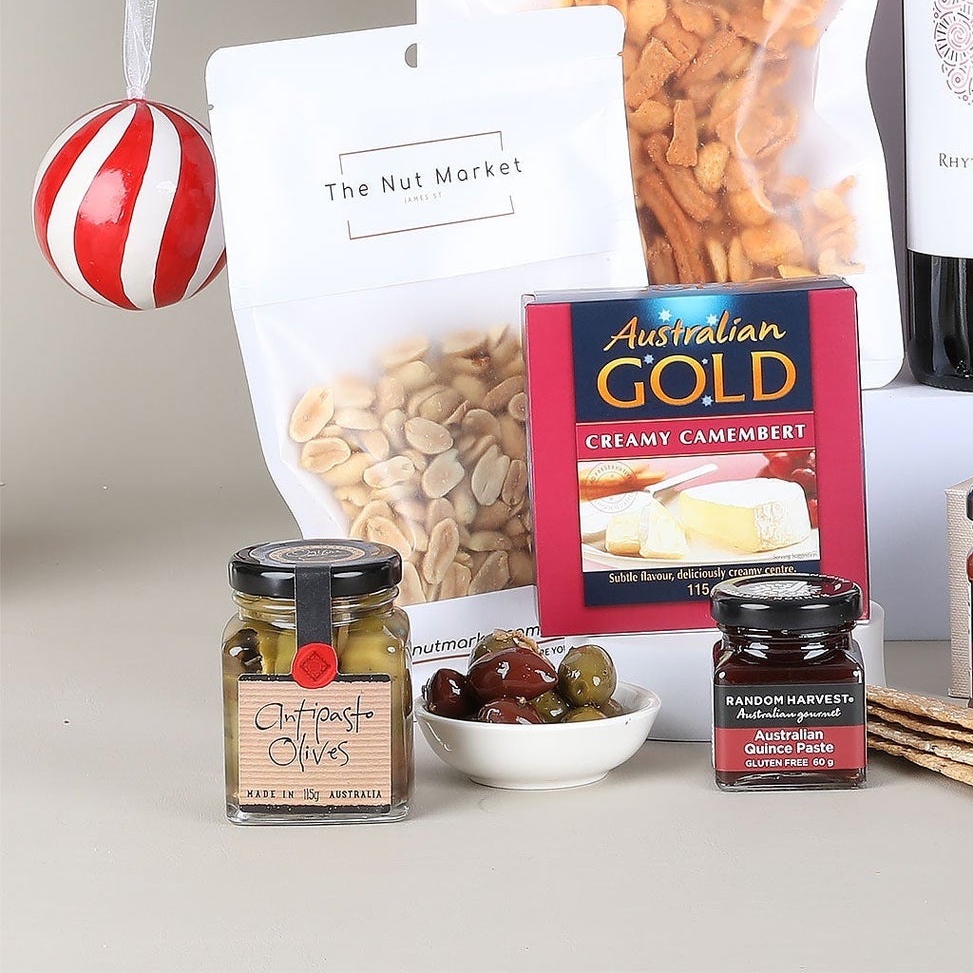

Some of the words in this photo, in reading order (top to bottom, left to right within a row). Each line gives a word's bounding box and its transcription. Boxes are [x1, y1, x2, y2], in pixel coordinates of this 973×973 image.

[325, 182, 369, 201] The
[382, 172, 423, 194] Nut
[435, 157, 523, 185] Market
[603, 309, 786, 352] Australian
[596, 350, 797, 409] GOLD
[585, 430, 671, 451] CREAMY
[680, 424, 806, 445] CAMEMBERT
[608, 571, 638, 584] Subtle
[640, 569, 675, 583] flavour,
[677, 565, 726, 581] deliciously
[764, 564, 797, 575] centre.
[726, 696, 784, 706] RANDOM
[736, 707, 796, 720] Australian
[796, 707, 842, 724] gourmet
[755, 728, 824, 742] Australian
[268, 733, 350, 772] Olives
[744, 743, 793, 755] Quince
[796, 742, 835, 754] Paste
[745, 759, 783, 768] GLUTEN
[784, 758, 809, 767] FREE
[812, 757, 826, 767] 60
[247, 789, 276, 799] MADE
[282, 790, 295, 799] IN
[303, 788, 320, 802] 115g
[329, 789, 382, 799] AUSTRALIA
